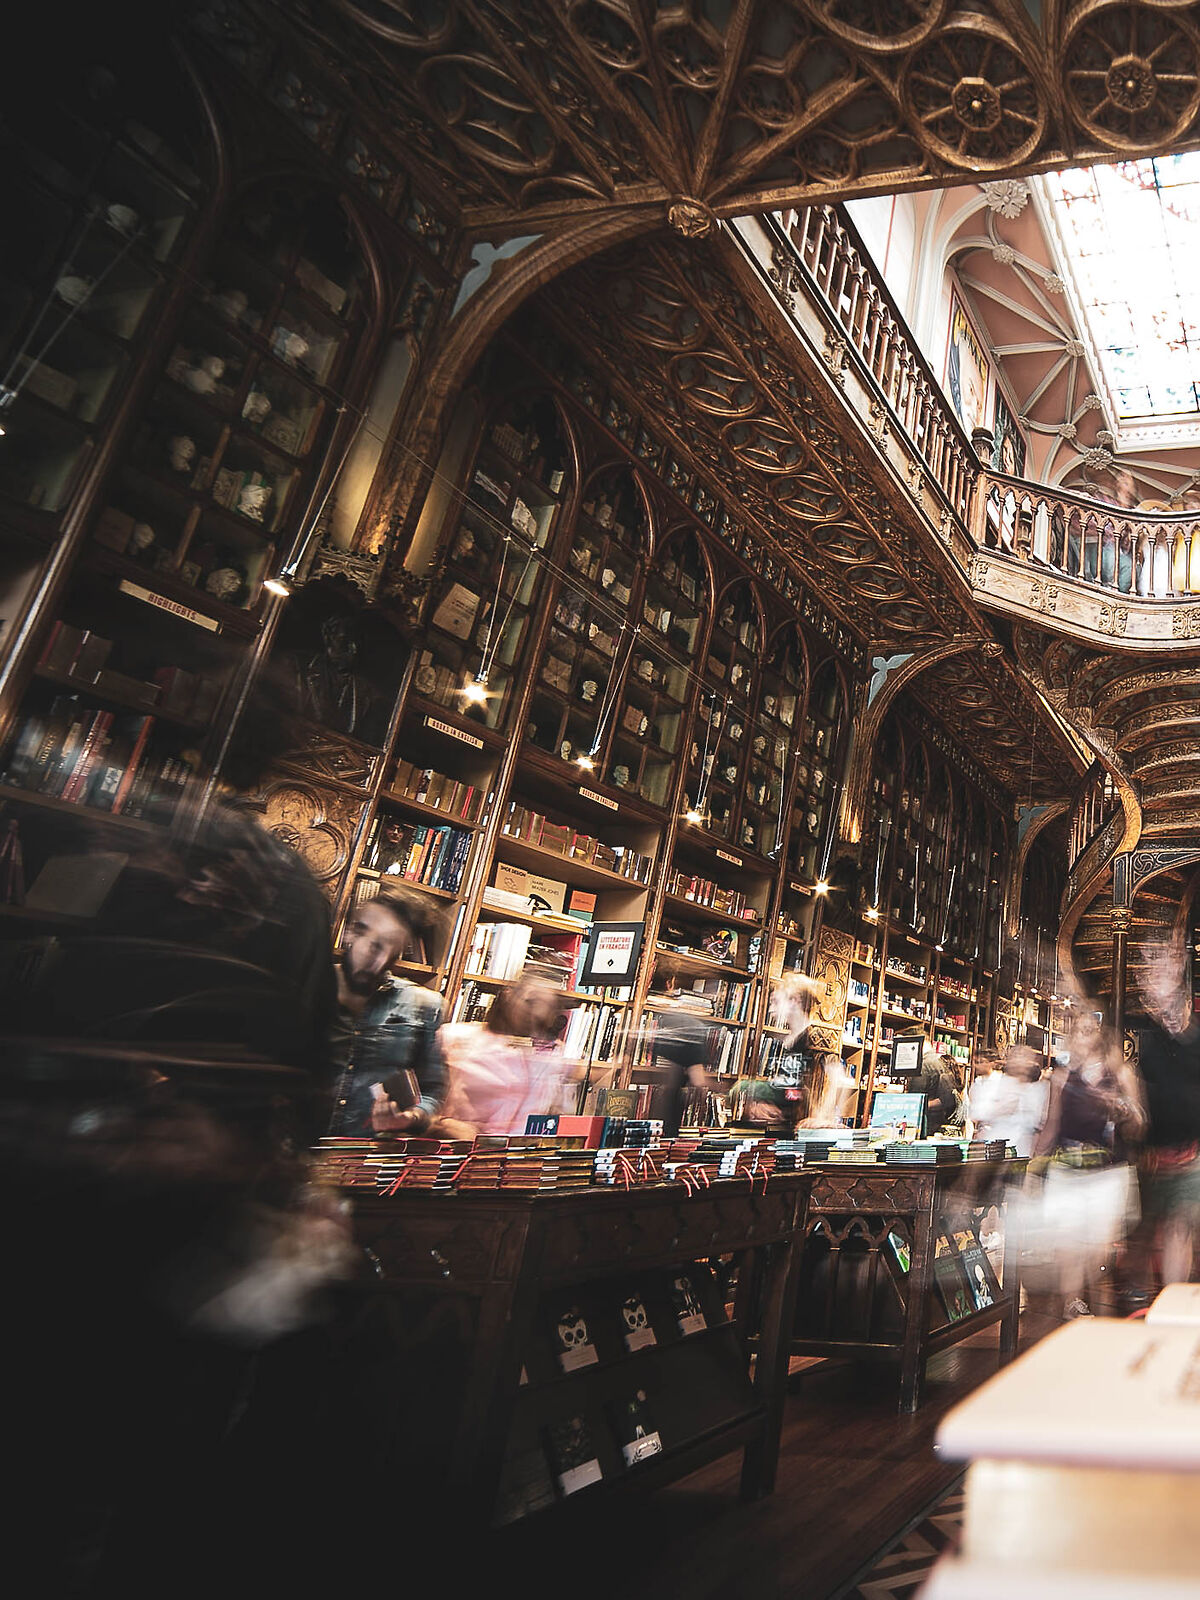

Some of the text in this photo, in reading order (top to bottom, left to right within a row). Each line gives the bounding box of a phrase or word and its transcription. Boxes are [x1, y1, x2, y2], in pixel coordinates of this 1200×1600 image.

[147, 593, 198, 620] HIGHLIGHTS
[432, 720, 450, 733] BOOKS
[457, 731, 479, 746] ENGLISH
[500, 865, 527, 878] SHOE DESIGN
